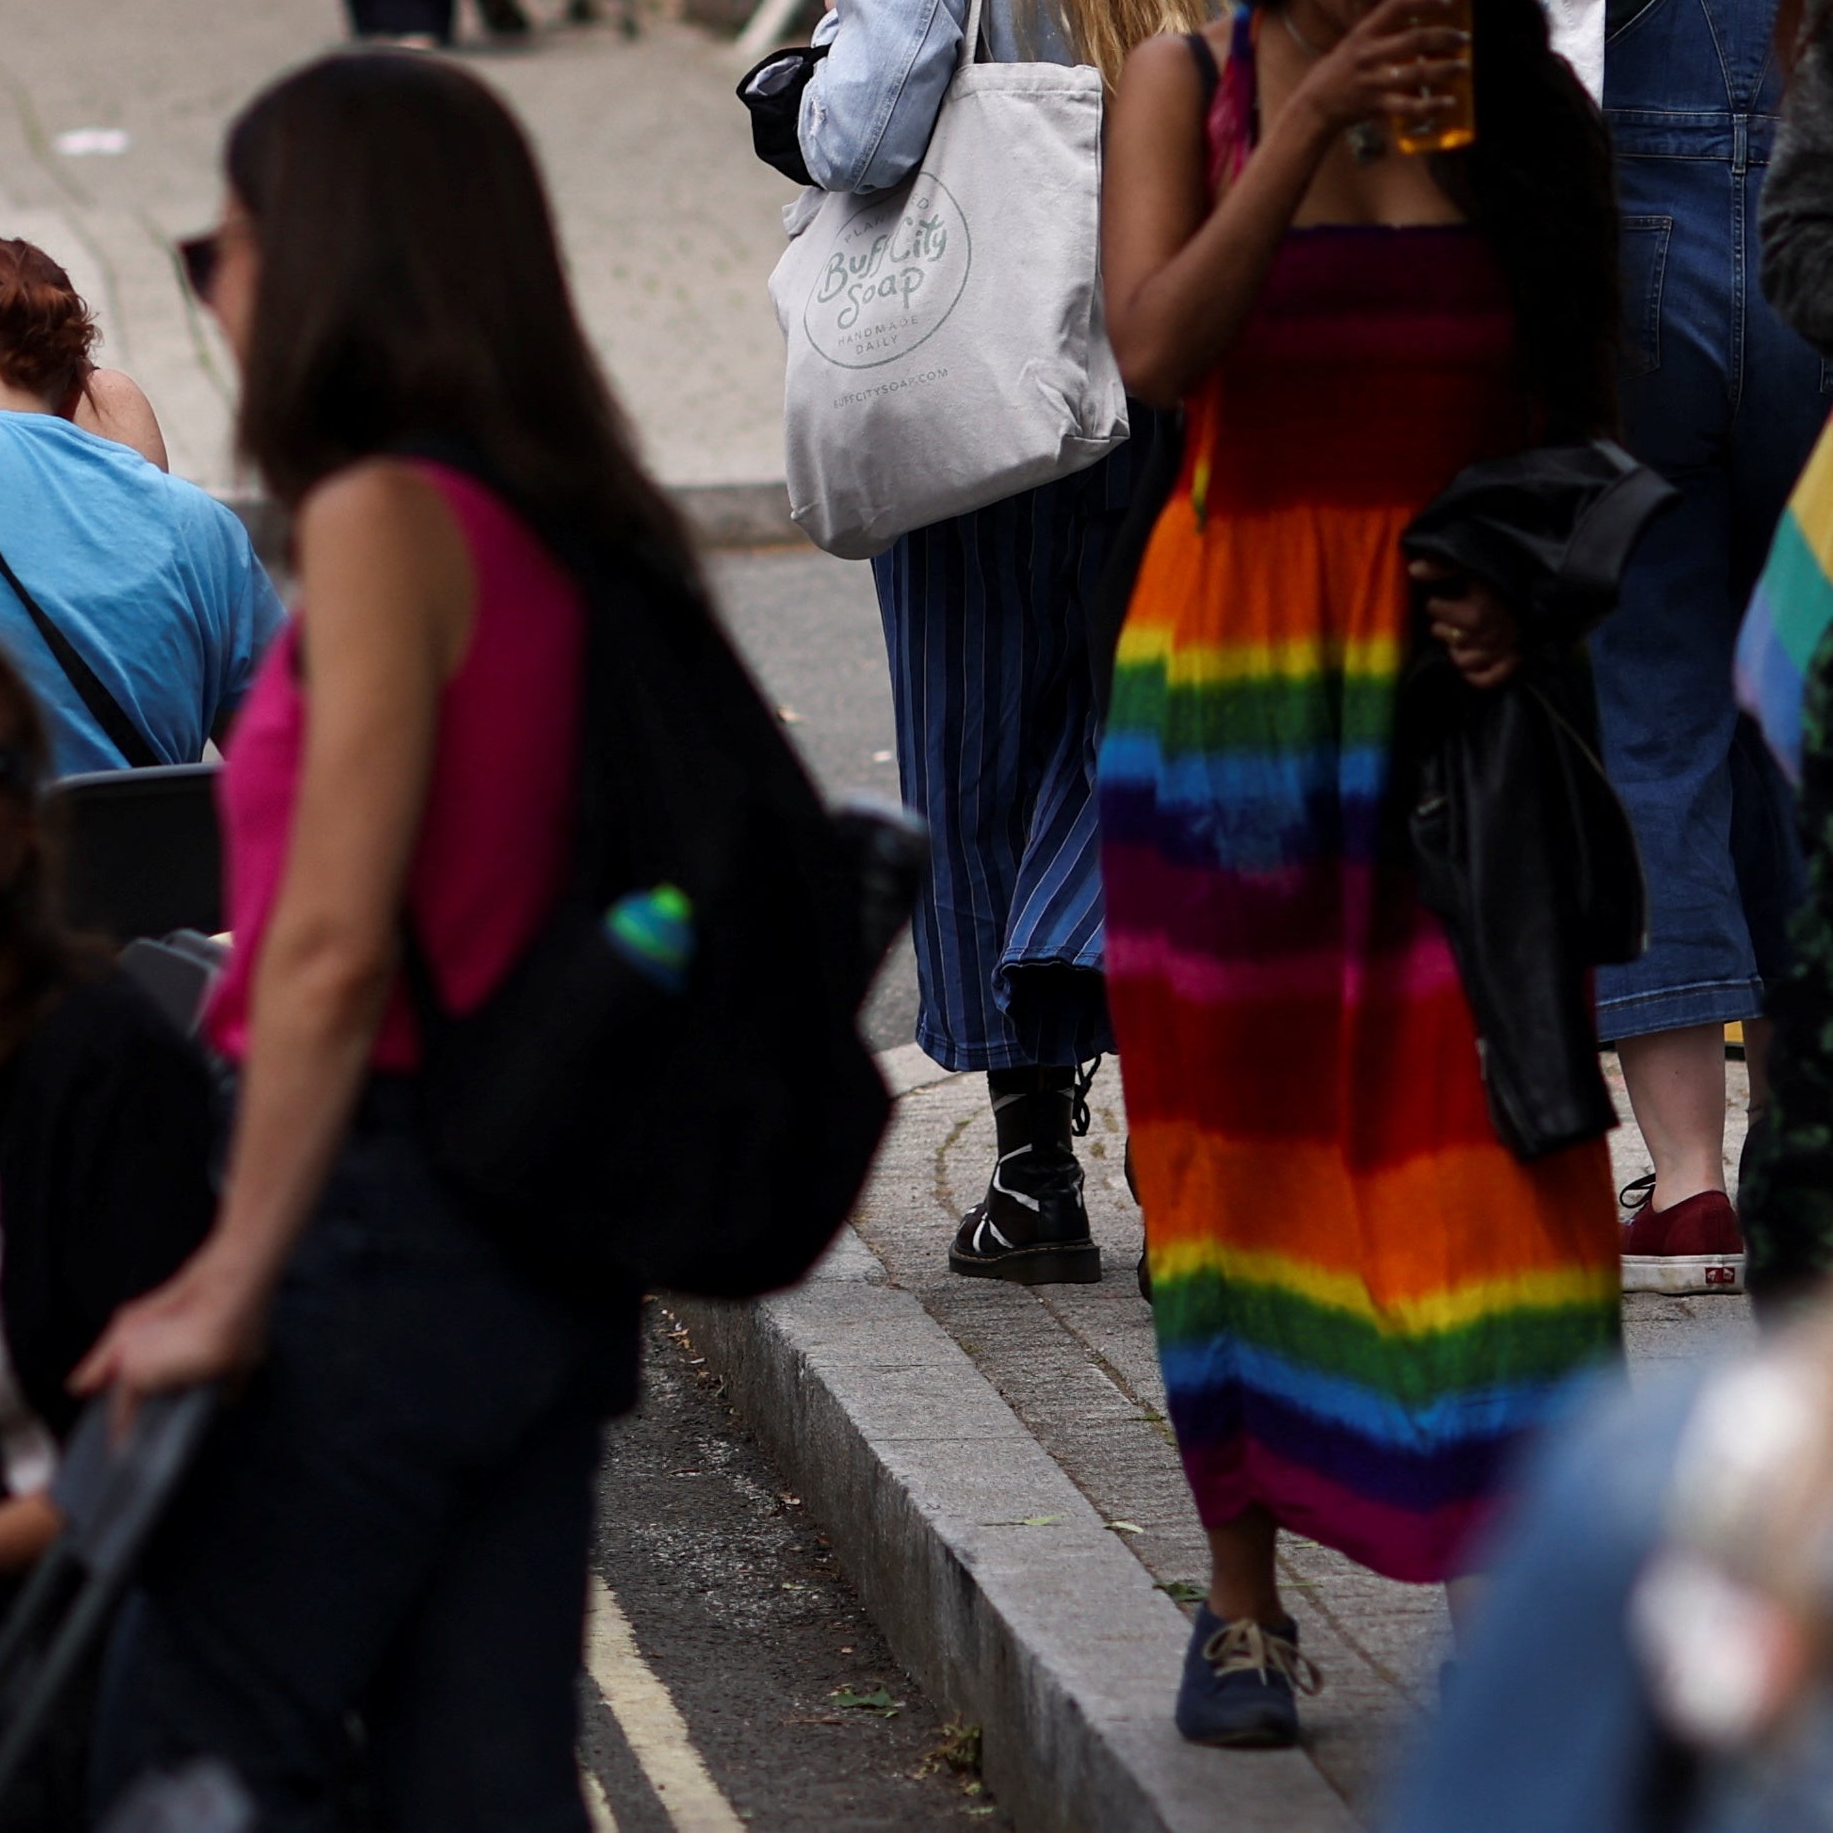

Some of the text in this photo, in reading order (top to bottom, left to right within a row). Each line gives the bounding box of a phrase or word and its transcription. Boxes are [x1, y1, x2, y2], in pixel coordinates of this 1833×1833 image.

[836, 267, 925, 330] Soap
[837, 315, 919, 347] HANDMADE
[855, 334, 898, 356] DAILY
[833, 368, 949, 409] BUFFCITYSOAP.COM
